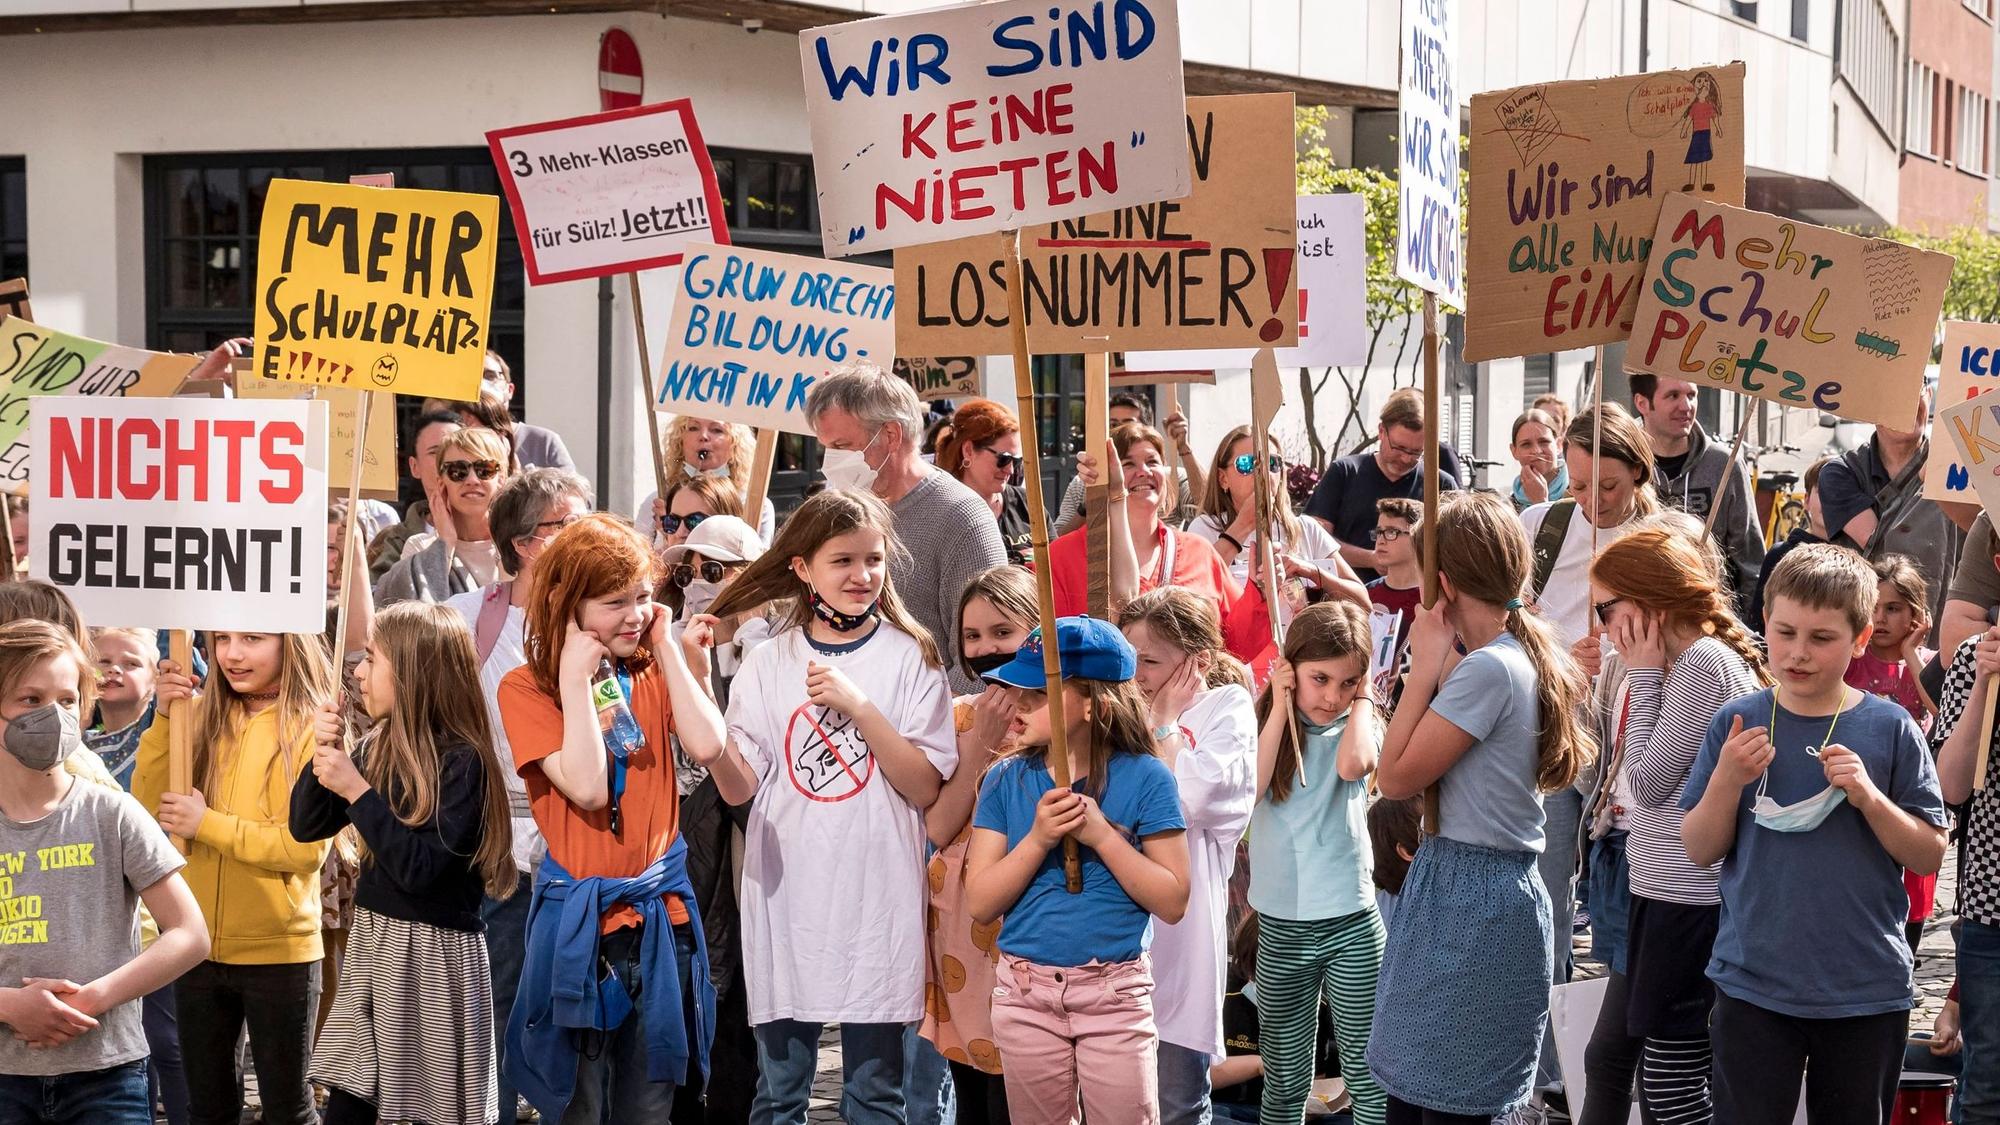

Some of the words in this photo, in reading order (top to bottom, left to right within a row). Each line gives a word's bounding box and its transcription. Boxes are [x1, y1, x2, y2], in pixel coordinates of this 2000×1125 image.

[509, 151, 533, 178] 3
[1507, 162, 1578, 225] Wir
[1588, 149, 1654, 209] sind
[281, 203, 483, 298] MEHR
[533, 229, 562, 249] für
[568, 217, 616, 244] Sülz!
[620, 197, 708, 238] Jetzt!!
[1508, 222, 1576, 273] alle
[1671, 209, 1833, 280] Mehr
[918, 247, 1295, 342] LOSNUMMER!
[658, 360, 748, 407] NICHT
[746, 372, 783, 408] IN
[49, 416, 305, 505] NICHTS
[48, 523, 303, 595] GELERNT!
[36, 843, 95, 871] YORK
